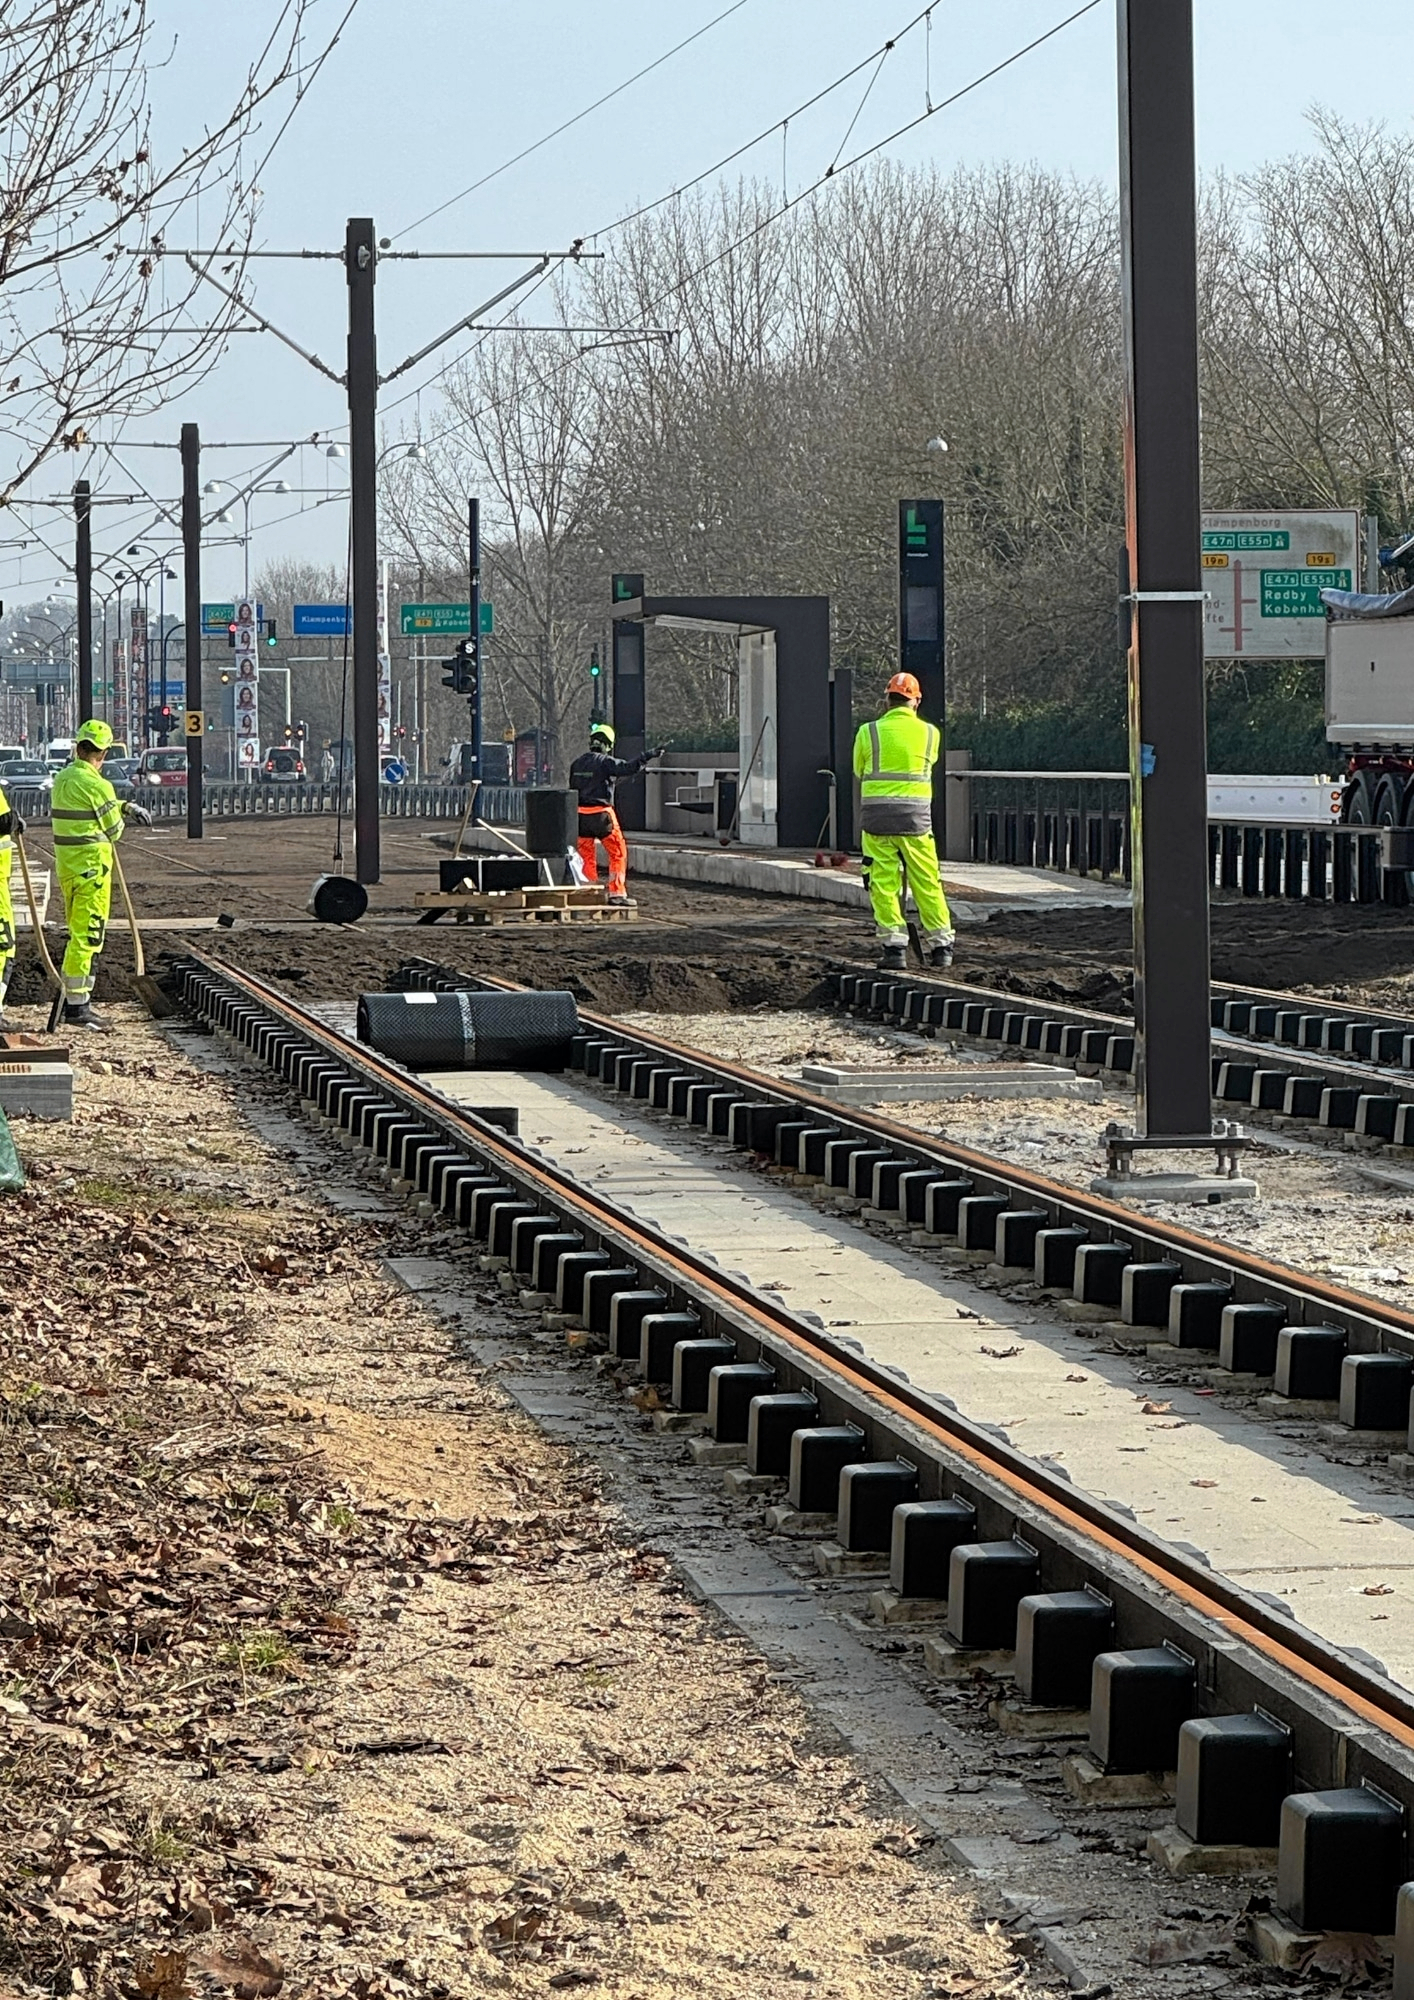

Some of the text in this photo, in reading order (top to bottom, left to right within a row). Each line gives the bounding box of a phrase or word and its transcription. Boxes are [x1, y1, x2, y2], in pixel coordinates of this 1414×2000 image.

[1203, 536, 1269, 546] E47n E55n
[1205, 557, 1224, 565] 19n
[1312, 555, 1330, 564] 19s
[1267, 575, 1332, 584] E47s E55s
[1264, 590, 1307, 602] Rødby
[1264, 603, 1324, 614] Københa
[188, 714, 201, 732] 3
